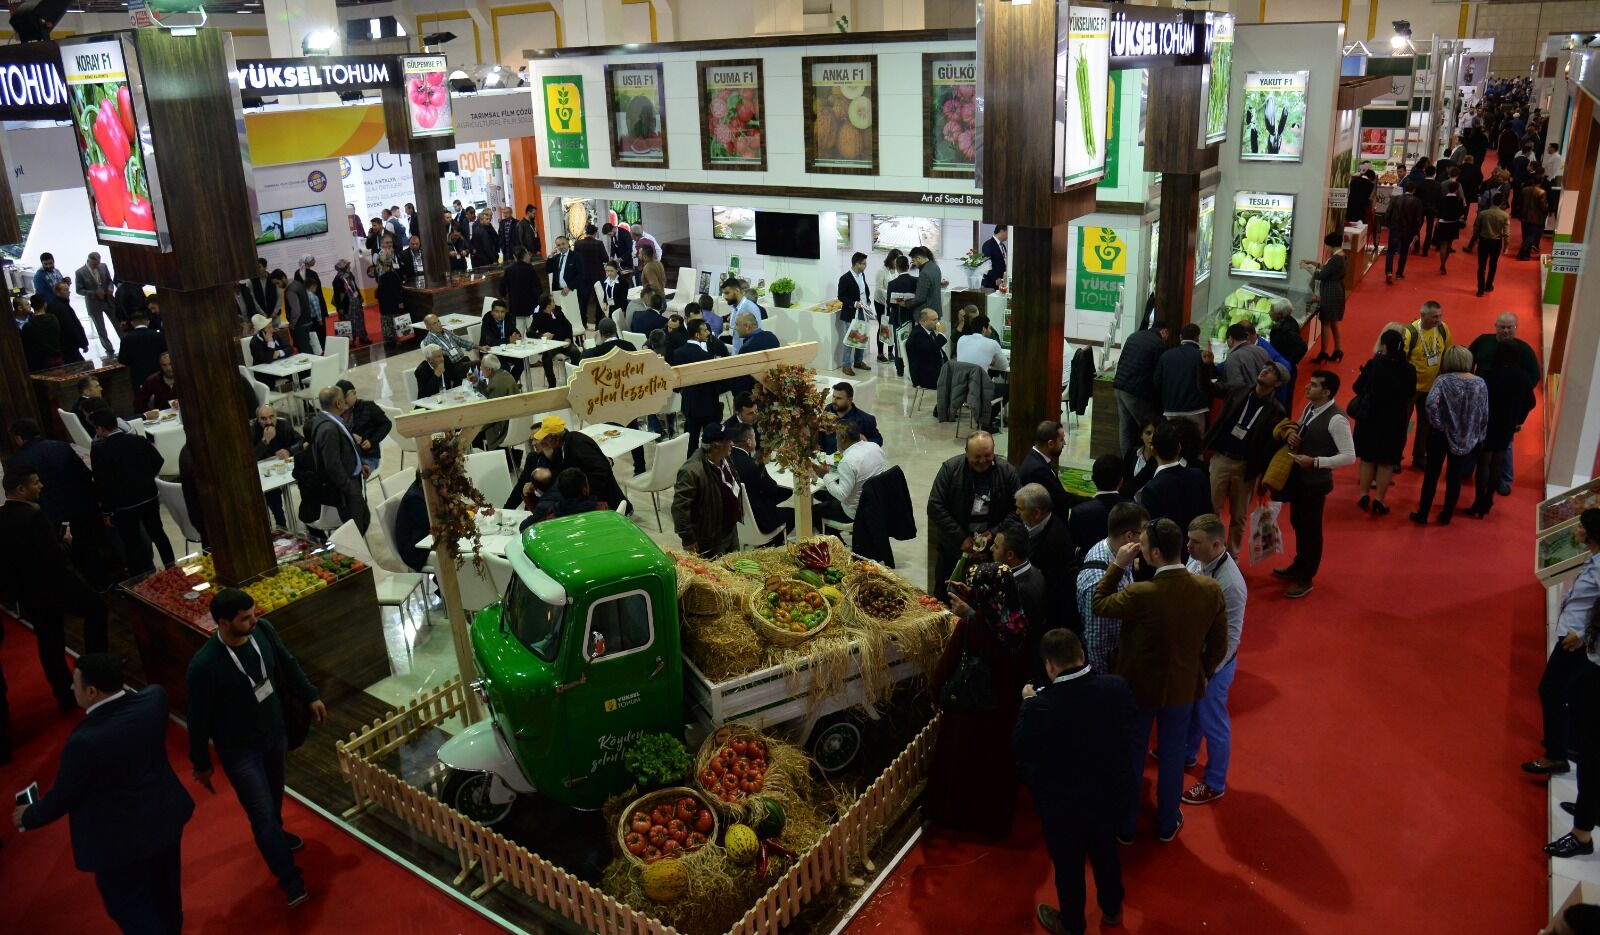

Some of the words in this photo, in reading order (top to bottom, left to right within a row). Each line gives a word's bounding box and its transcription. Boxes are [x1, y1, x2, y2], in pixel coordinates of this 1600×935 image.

[1158, 22, 1195, 56] TOHUM
[76, 55, 100, 71] KORAY
[102, 53, 112, 69] F1
[322, 63, 390, 85] TOHUM
[713, 72, 741, 84] CUMA
[743, 72, 754, 84] F1
[823, 69, 850, 81] ANKA
[853, 69, 864, 81] F1
[937, 64, 976, 80] GÜLKÖ
[622, 75, 643, 86] USTA
[644, 75, 654, 86] F1
[1260, 78, 1282, 86] YAKUT
[921, 194, 932, 202] Art
[934, 194, 943, 202] of
[945, 195, 964, 204] Seed
[1249, 198, 1269, 206] TESLA
[1271, 199, 1280, 207] F1
[591, 362, 645, 389] Köyden
[587, 388, 617, 415] gelen
